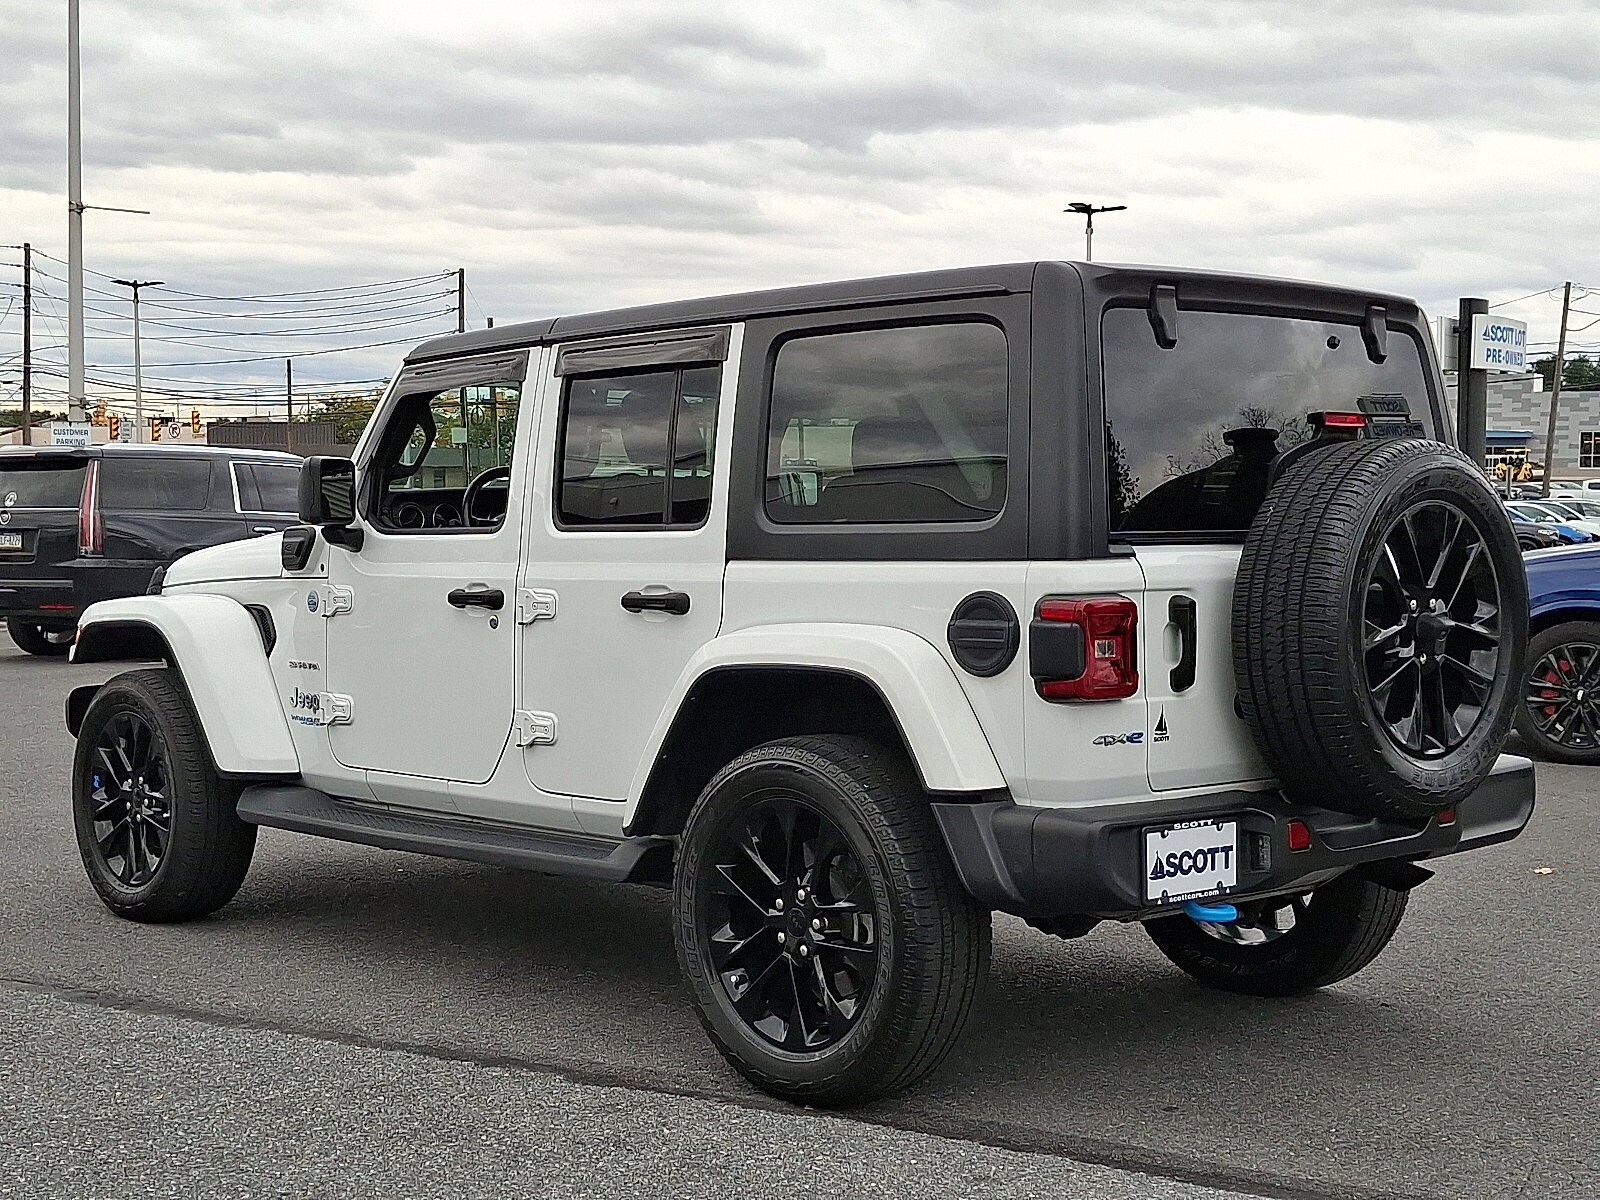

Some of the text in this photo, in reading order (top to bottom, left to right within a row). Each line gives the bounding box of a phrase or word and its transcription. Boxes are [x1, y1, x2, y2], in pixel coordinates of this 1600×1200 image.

[1490, 324, 1526, 346] SCOTT LOT
[1485, 347, 1523, 367] PRE-OWNED
[53, 428, 89, 437] CUSTOMER
[56, 438, 86, 446] PARKING
[291, 688, 320, 714] Jeep
[1154, 735, 1169, 743] SCOTT
[1174, 819, 1214, 829] SCOTT
[1166, 846, 1233, 877] SCOTT
[1169, 889, 1220, 904] scottcars.com
